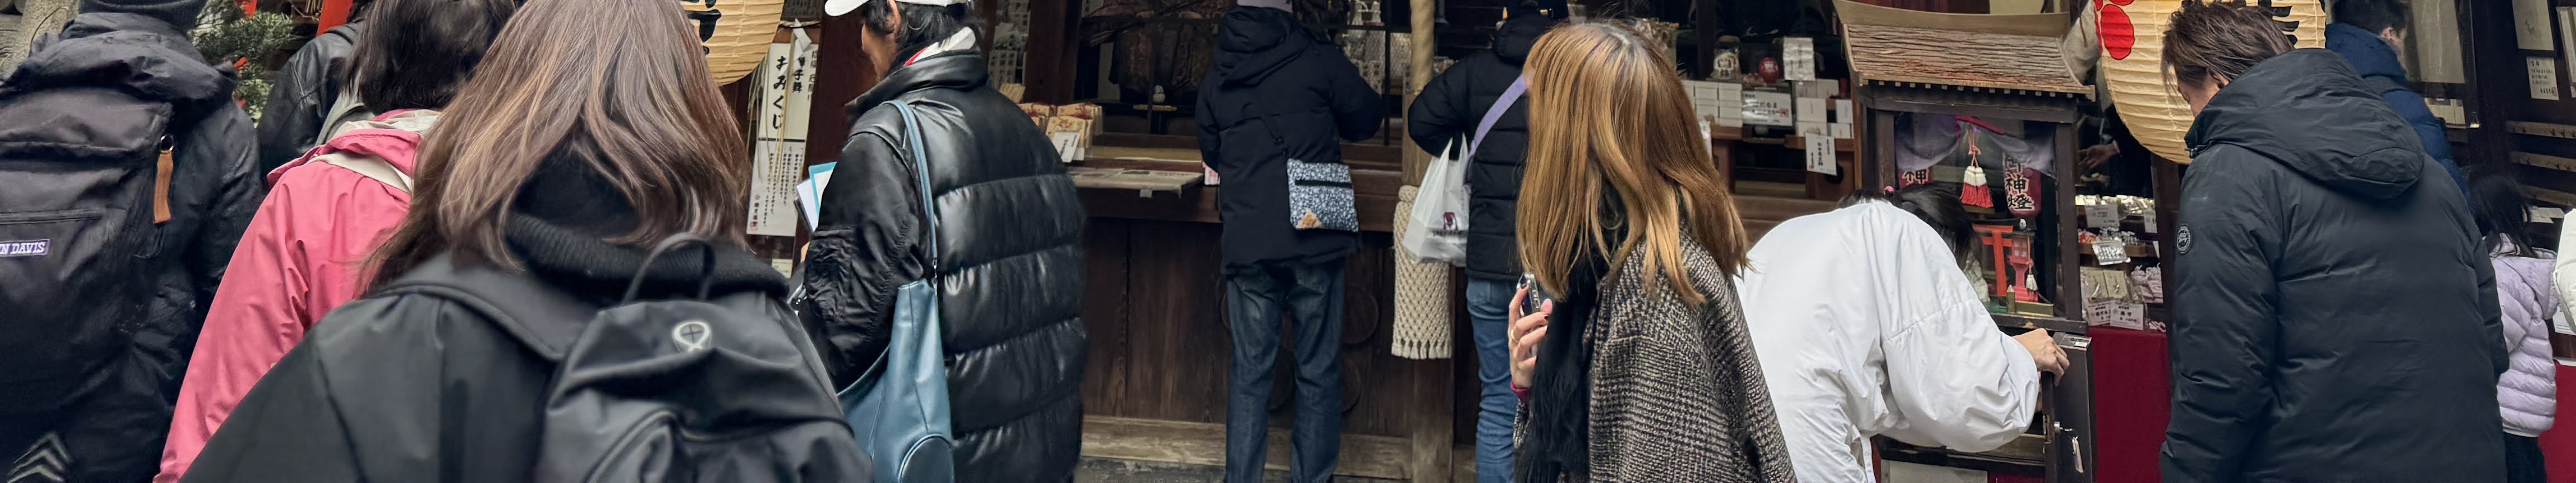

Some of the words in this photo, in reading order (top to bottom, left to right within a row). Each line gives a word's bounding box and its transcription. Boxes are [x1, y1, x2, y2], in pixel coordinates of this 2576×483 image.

[773, 56, 788, 129] おみくじ
[9, 241, 45, 254] DAVIS
